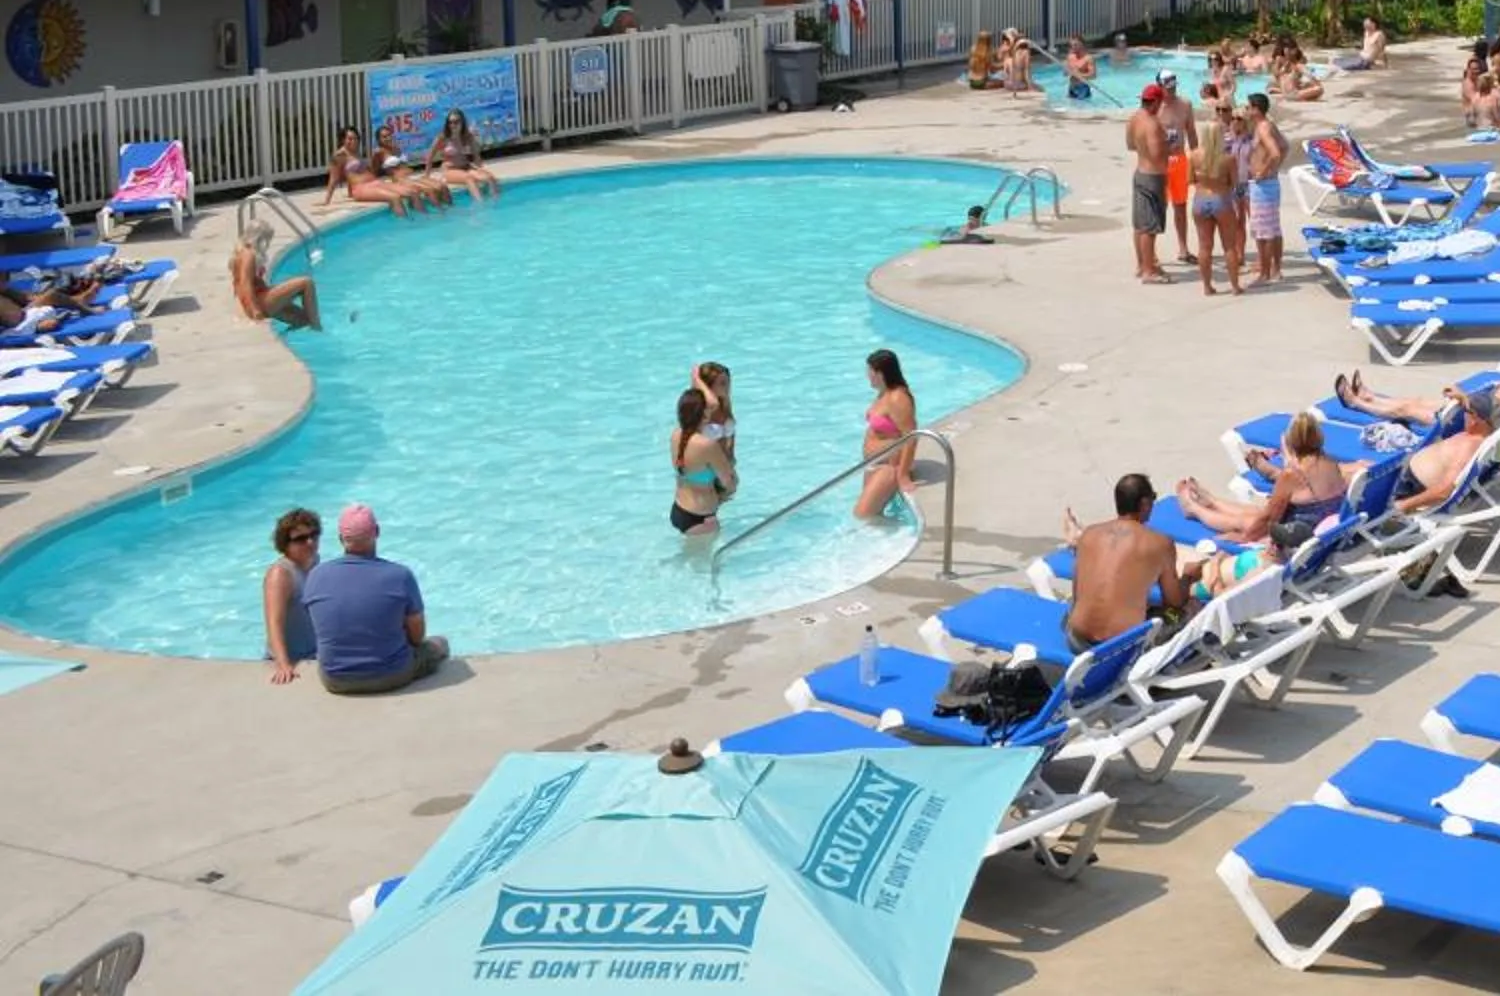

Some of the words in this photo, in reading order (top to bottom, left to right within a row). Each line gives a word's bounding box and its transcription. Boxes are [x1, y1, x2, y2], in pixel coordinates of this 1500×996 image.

[815, 773, 902, 889] CRUZAN
[873, 889, 900, 915] THE
[500, 901, 753, 936] CRUZAN
[473, 959, 523, 981] THE
[528, 959, 601, 980] DON'T
[606, 959, 688, 981] HURRY
